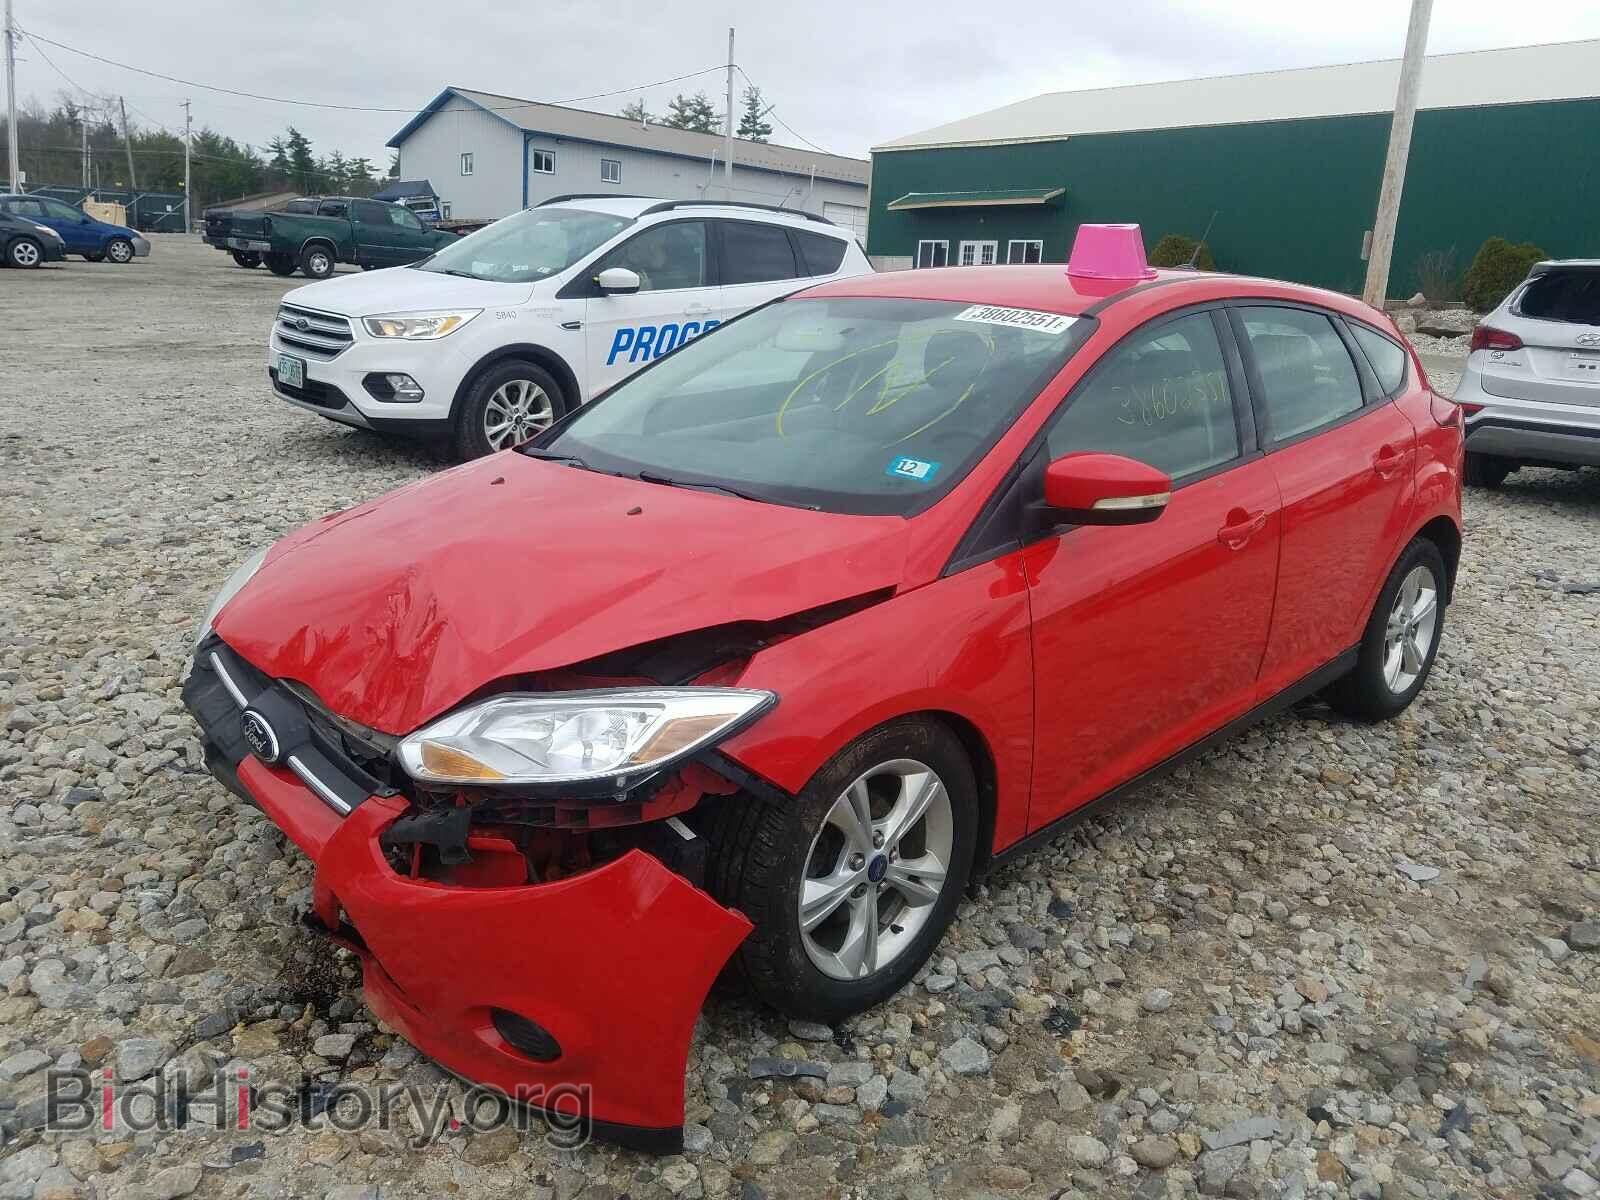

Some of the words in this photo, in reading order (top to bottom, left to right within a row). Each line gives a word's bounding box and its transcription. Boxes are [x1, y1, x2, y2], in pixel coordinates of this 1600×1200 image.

[972, 307, 1061, 329] 38602551
[606, 319, 722, 366] PROG
[896, 460, 918, 474] 12
